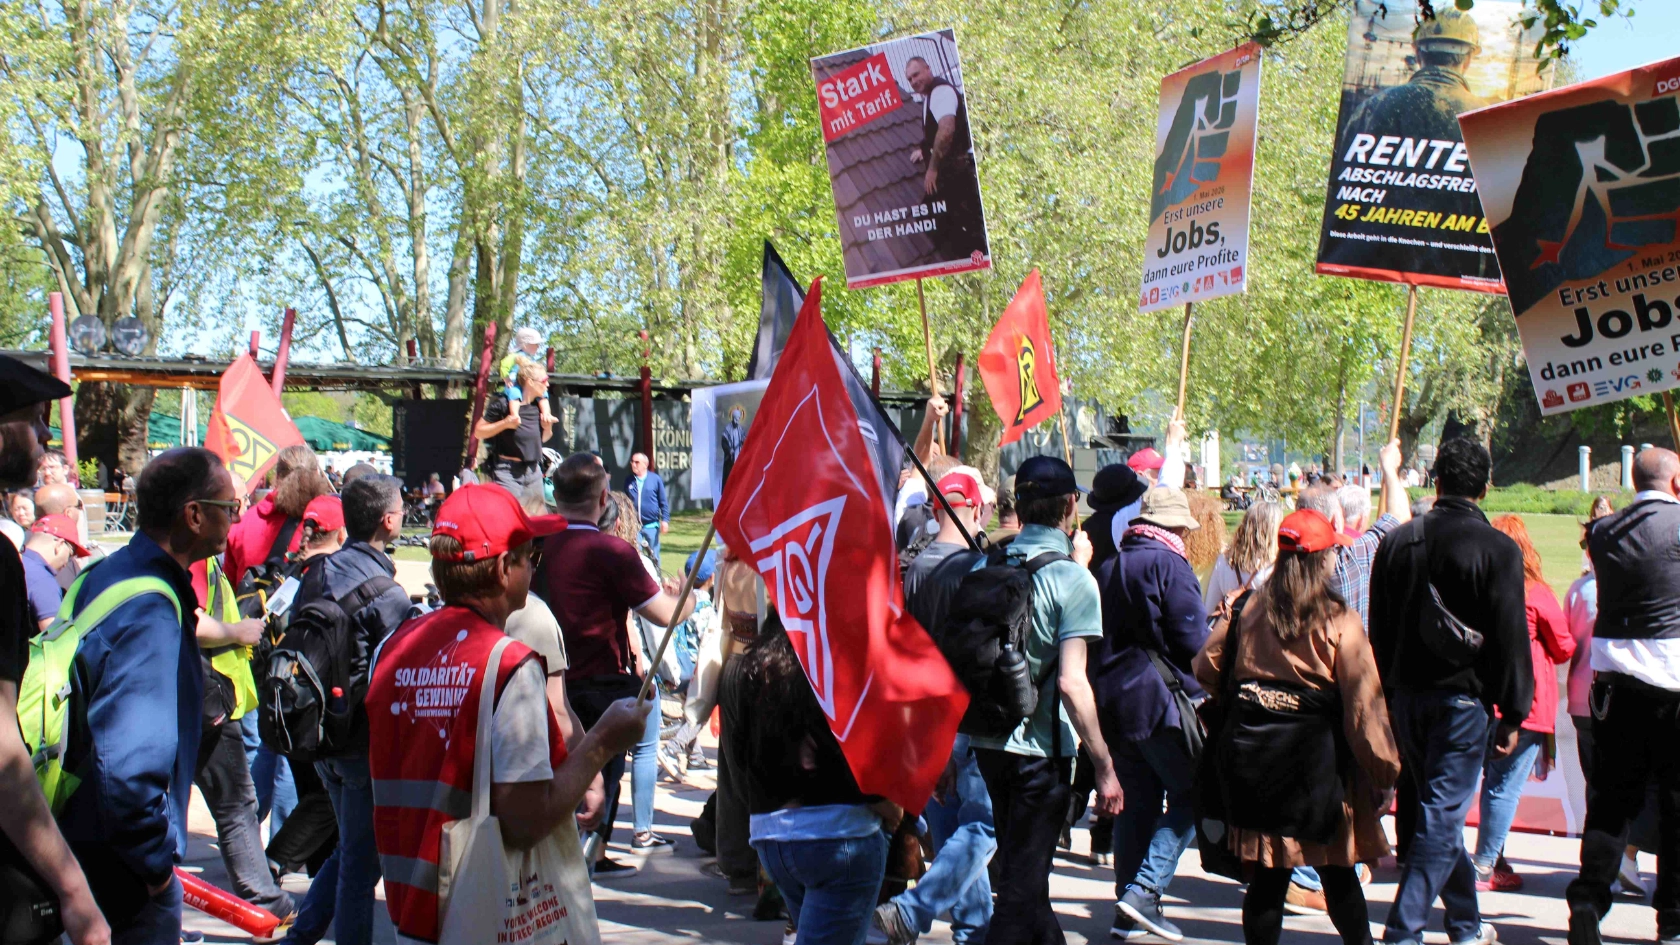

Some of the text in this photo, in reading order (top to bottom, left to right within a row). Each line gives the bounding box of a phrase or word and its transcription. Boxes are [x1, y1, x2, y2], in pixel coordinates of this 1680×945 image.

[821, 62, 887, 108] Stark
[1657, 76, 1680, 94] DG
[830, 89, 897, 133] mit Tarif.
[1343, 133, 1468, 173] RENTE
[1199, 190, 1210, 200] Mai
[1336, 186, 1387, 203] NACH
[853, 200, 947, 228] DU HAST ES IN
[1164, 197, 1224, 225] Erst unsere
[1334, 203, 1361, 220] 45
[1360, 206, 1442, 230] JAHREN
[1440, 214, 1477, 233] AM
[867, 218, 937, 242] DER HAND!
[1157, 219, 1225, 259] Jobs,
[1143, 248, 1239, 284] dann eure Profite
[1641, 254, 1664, 269] Mai
[1558, 280, 1610, 307] Erst
[1560, 293, 1680, 348] Job
[1540, 356, 1603, 382] dann
[1608, 342, 1665, 367] eure
[394, 661, 477, 687] SOLIDARITÄT
[497, 931, 508, 943] IN
